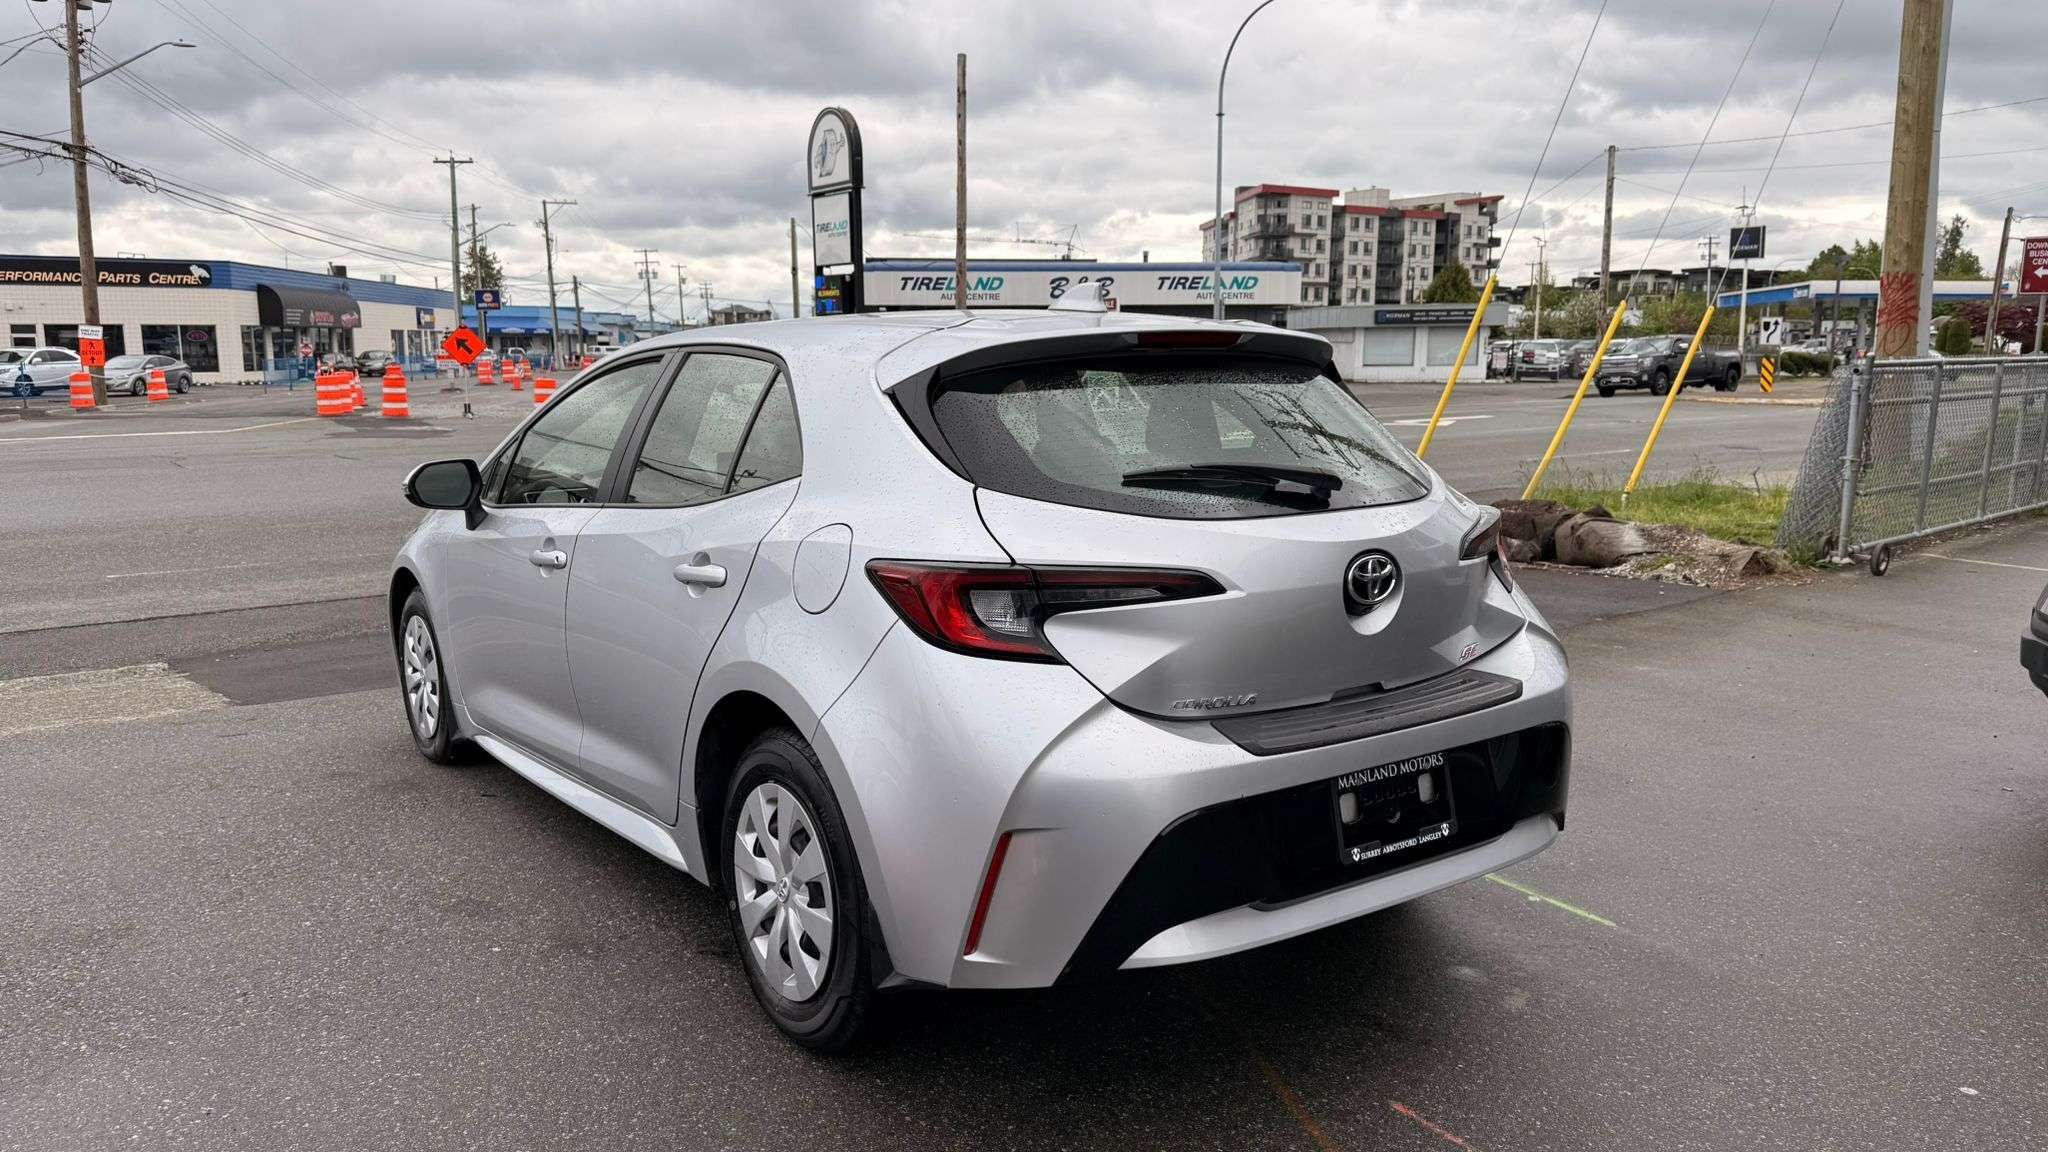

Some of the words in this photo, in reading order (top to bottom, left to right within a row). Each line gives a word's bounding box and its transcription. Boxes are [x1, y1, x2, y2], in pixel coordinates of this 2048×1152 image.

[0, 271, 81, 282] ERFORMANC
[98, 271, 141, 283] PARTS
[149, 272, 199, 284] CENTRE
[966, 292, 1000, 300] CENTRE
[1221, 291, 1255, 300] CENTRE
[1338, 764, 1397, 790] MAINLAND
[1400, 752, 1444, 775] MOTORS
[1361, 848, 1381, 860] SURREY
[1382, 838, 1418, 854] ABBOTSFORD
[1419, 830, 1442, 844] LANGLEY
